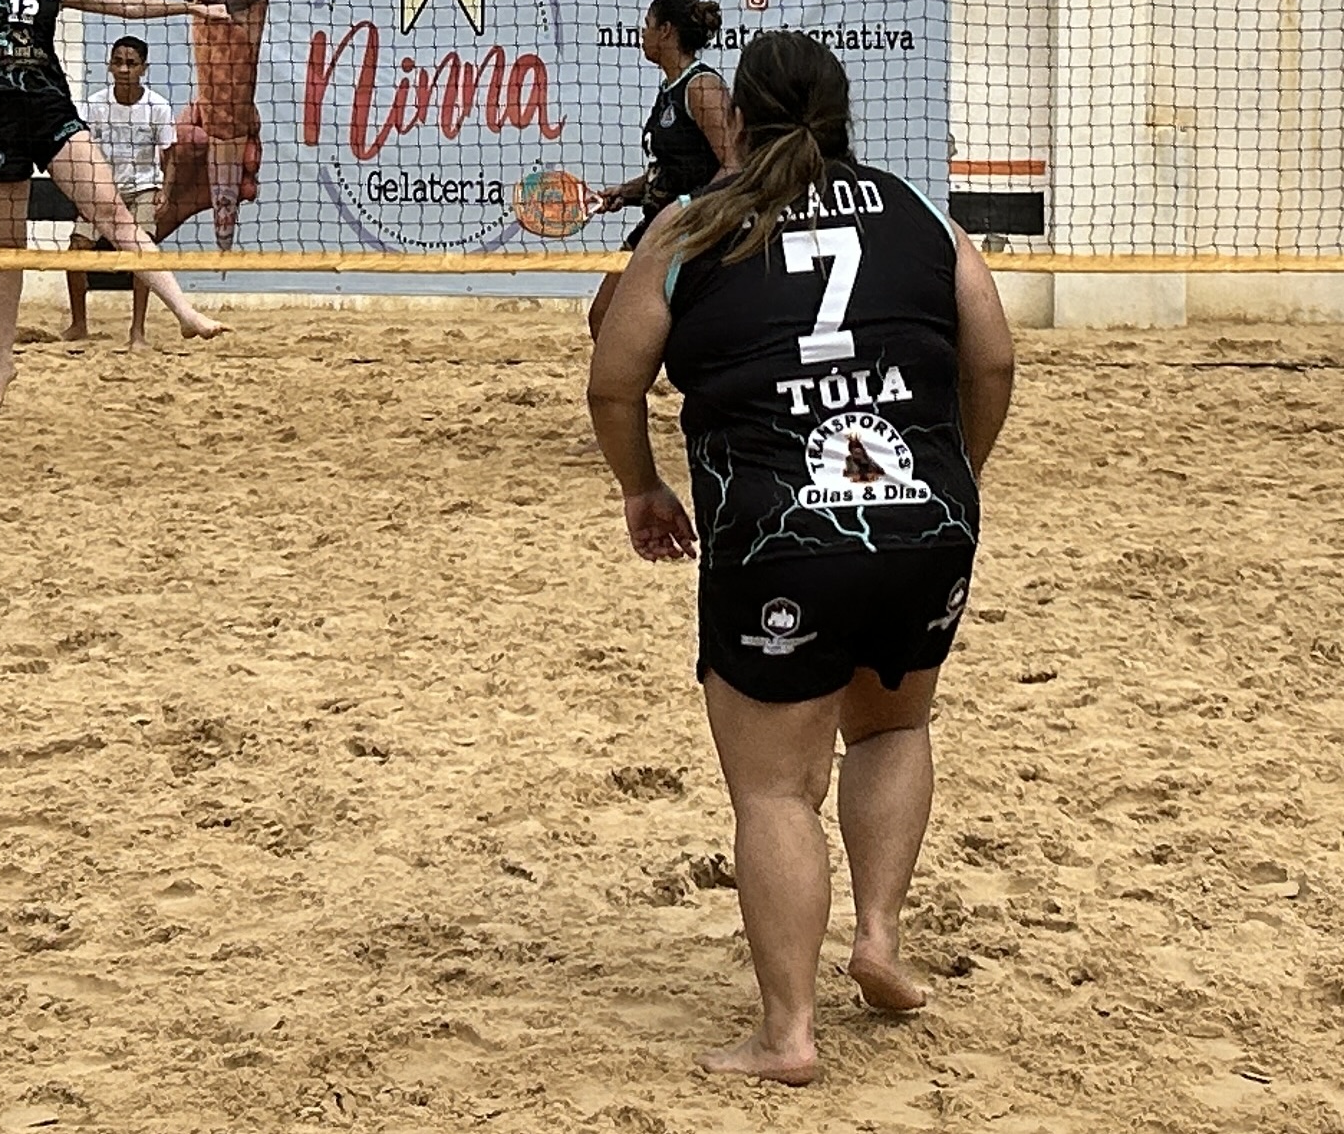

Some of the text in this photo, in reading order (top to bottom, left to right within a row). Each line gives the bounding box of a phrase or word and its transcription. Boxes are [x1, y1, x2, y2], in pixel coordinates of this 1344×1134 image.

[597, 21, 915, 50] ninlatcriativa
[304, 20, 567, 160] Ninna
[367, 171, 504, 205] Gelateria
[782, 226, 862, 365] 7
[776, 366, 913, 414] TÓIA
[806, 483, 927, 505] Dias & Dias
